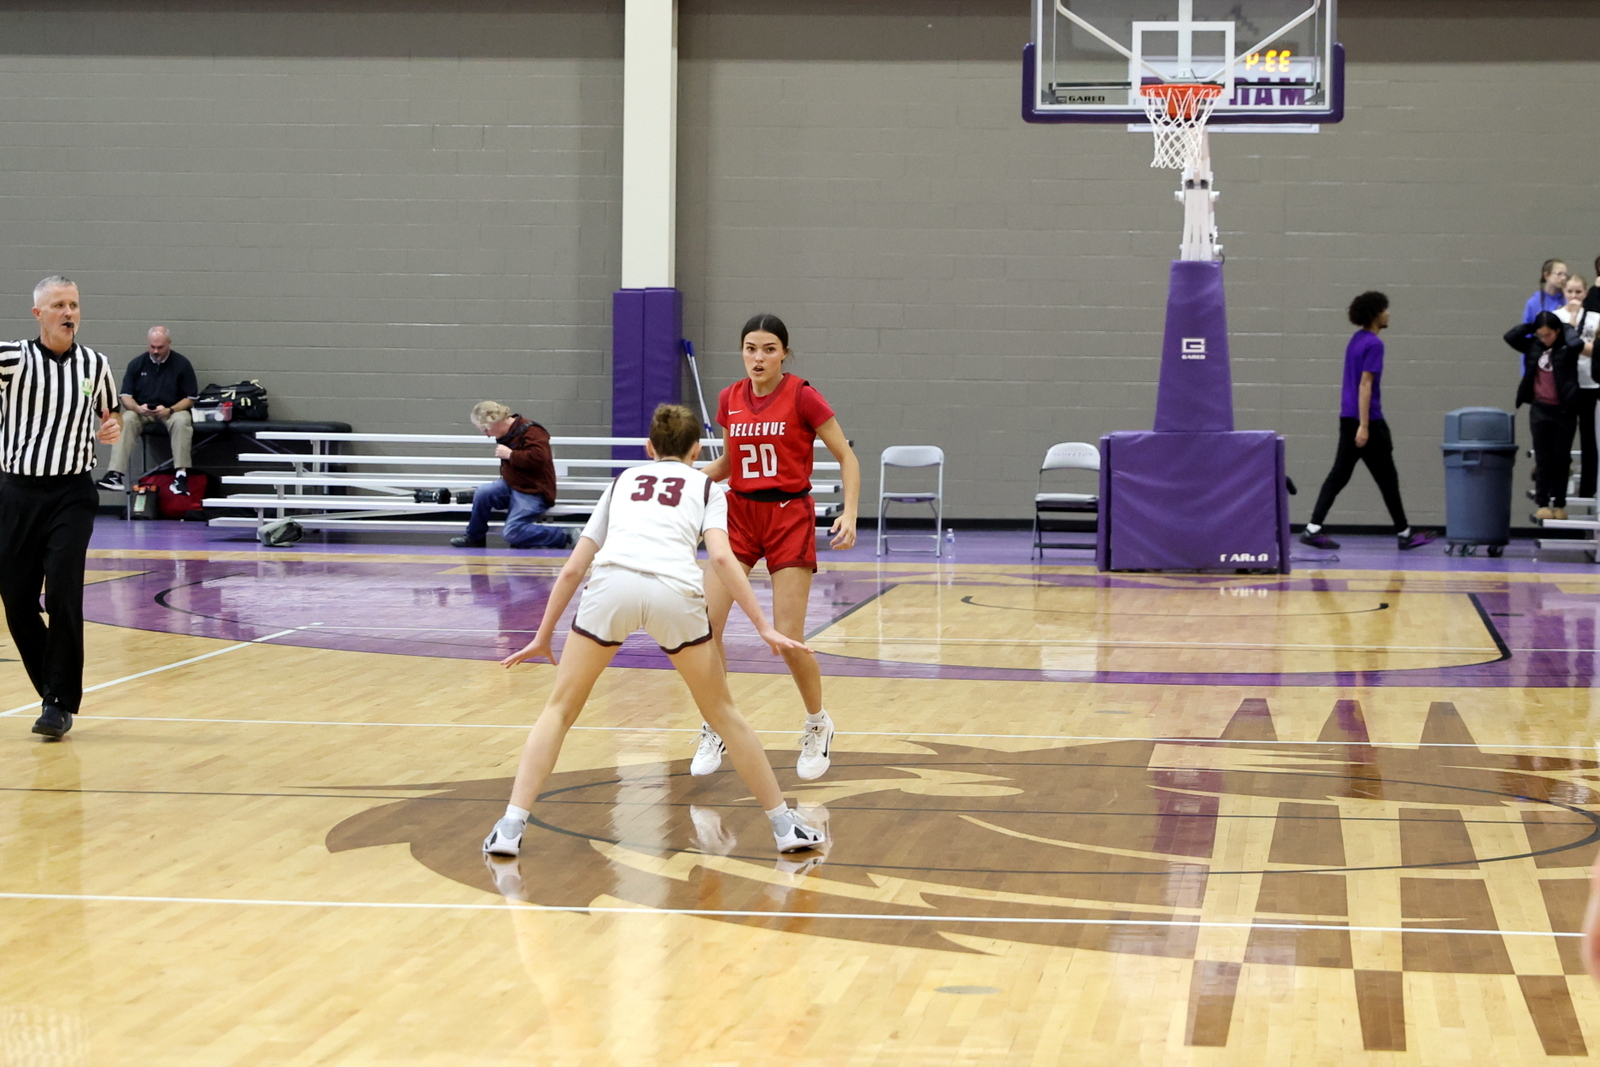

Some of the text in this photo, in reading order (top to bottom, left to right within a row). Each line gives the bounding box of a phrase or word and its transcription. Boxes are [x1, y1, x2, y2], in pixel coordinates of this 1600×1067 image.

[730, 422, 786, 437] BELLEVUE
[739, 443, 777, 479] 20
[630, 474, 686, 507] 33
